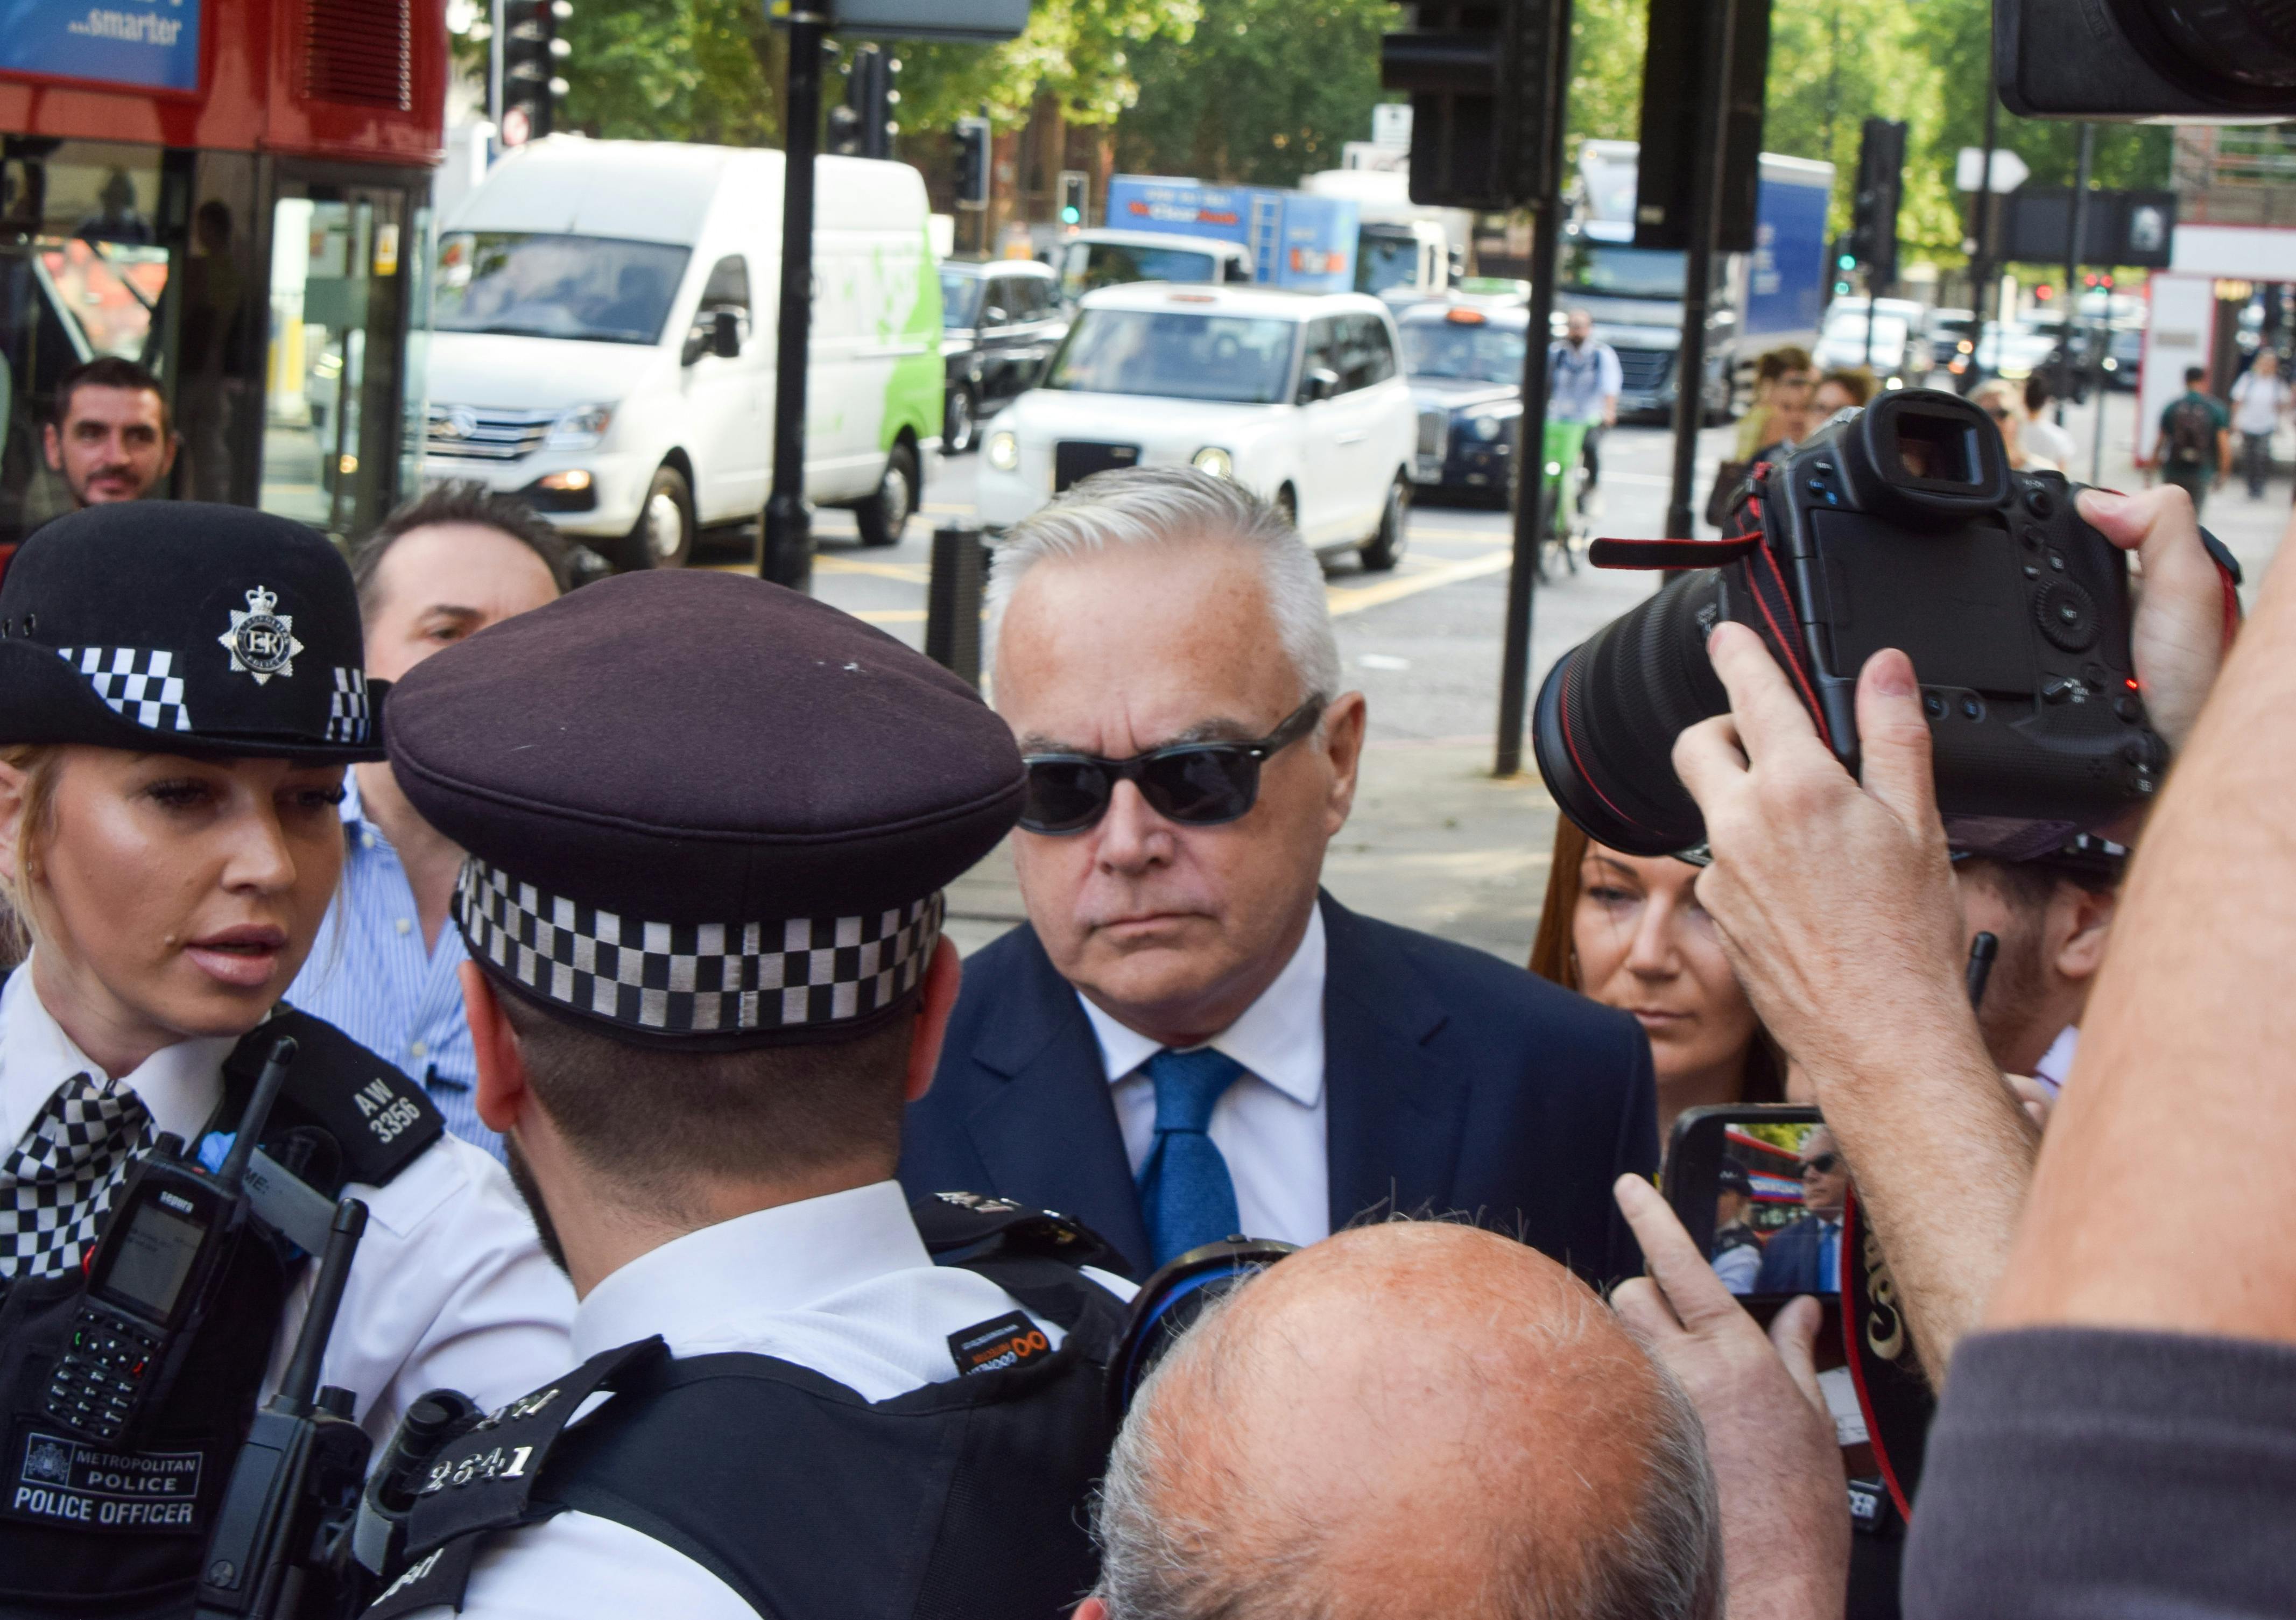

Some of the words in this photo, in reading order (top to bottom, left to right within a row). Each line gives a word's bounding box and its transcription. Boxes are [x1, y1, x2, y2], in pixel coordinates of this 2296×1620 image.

[67, 9, 183, 46] ...smarter
[353, 1077, 394, 1117] AW
[369, 1096, 421, 1144] 3356
[159, 1191, 194, 1214] sepura
[76, 1450, 196, 1473] METROPOLITAN
[418, 1446, 533, 1495] 2641
[87, 1471, 177, 1492] POLICE
[14, 1486, 94, 1522] POLICE
[100, 1501, 194, 1525] OFFICER
